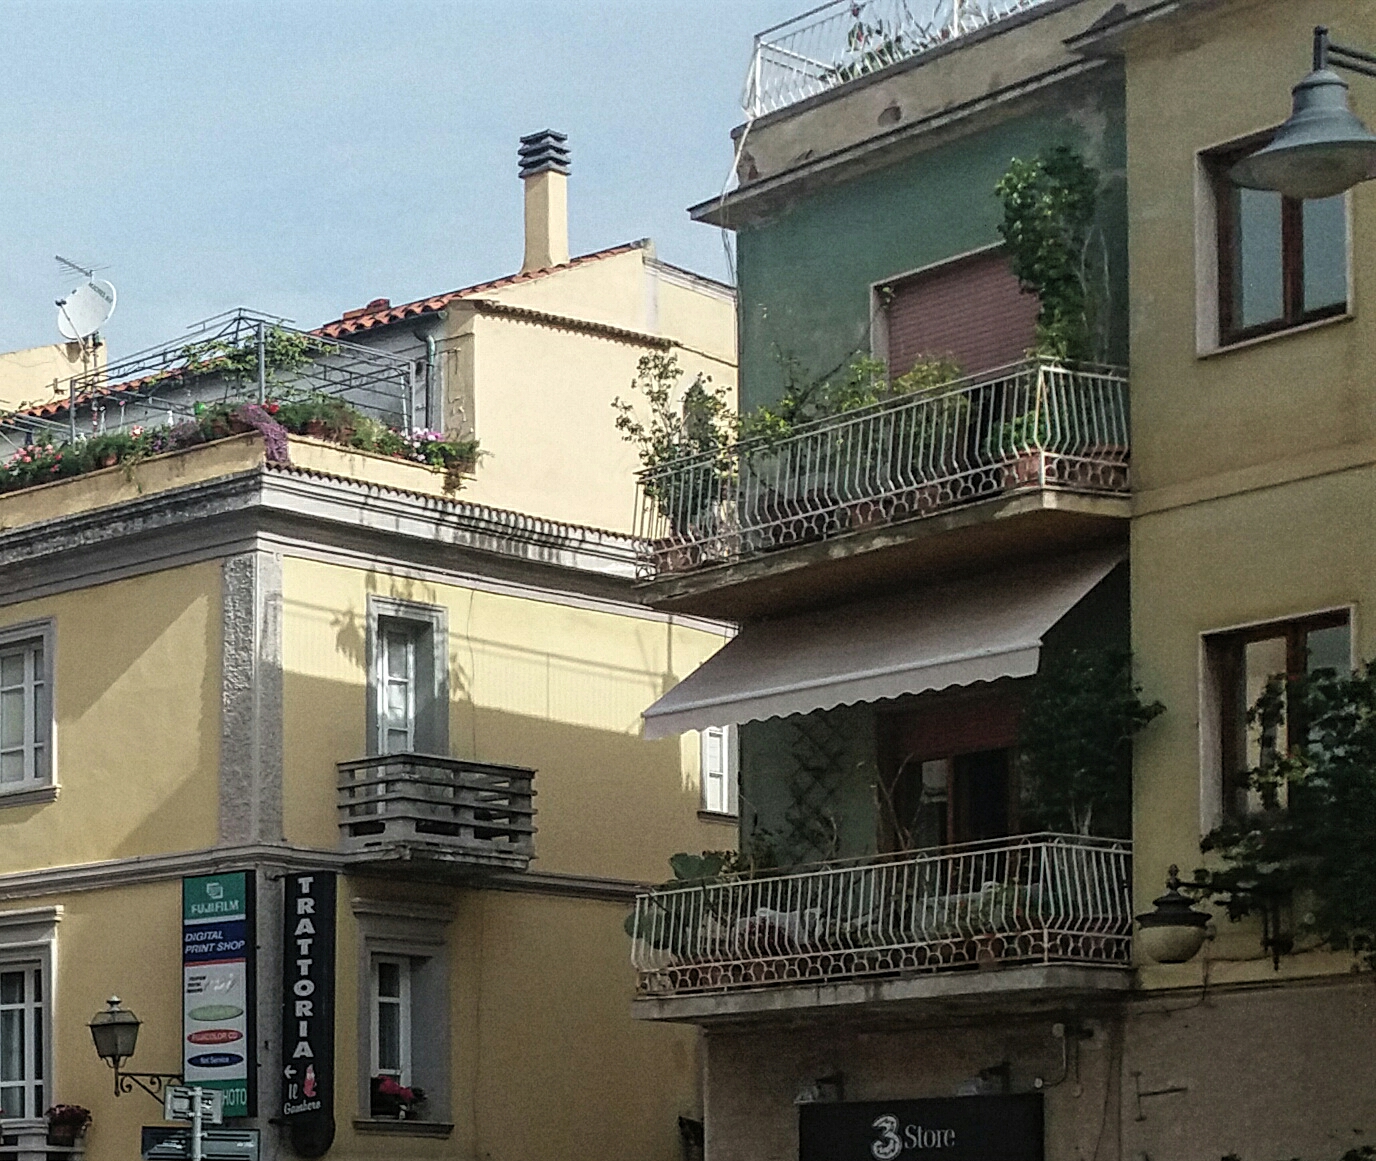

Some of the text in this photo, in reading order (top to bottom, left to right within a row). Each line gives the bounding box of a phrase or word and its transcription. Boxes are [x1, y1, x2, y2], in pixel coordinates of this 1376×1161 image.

[191, 900, 239, 914] FUJIFILM
[184, 930, 224, 942] DIGITAL
[184, 940, 246, 955] PRINT SHOP
[293, 877, 315, 1058] TRATTORIA
[222, 1088, 247, 1106] HOTO
[904, 1125, 956, 1149] Store
